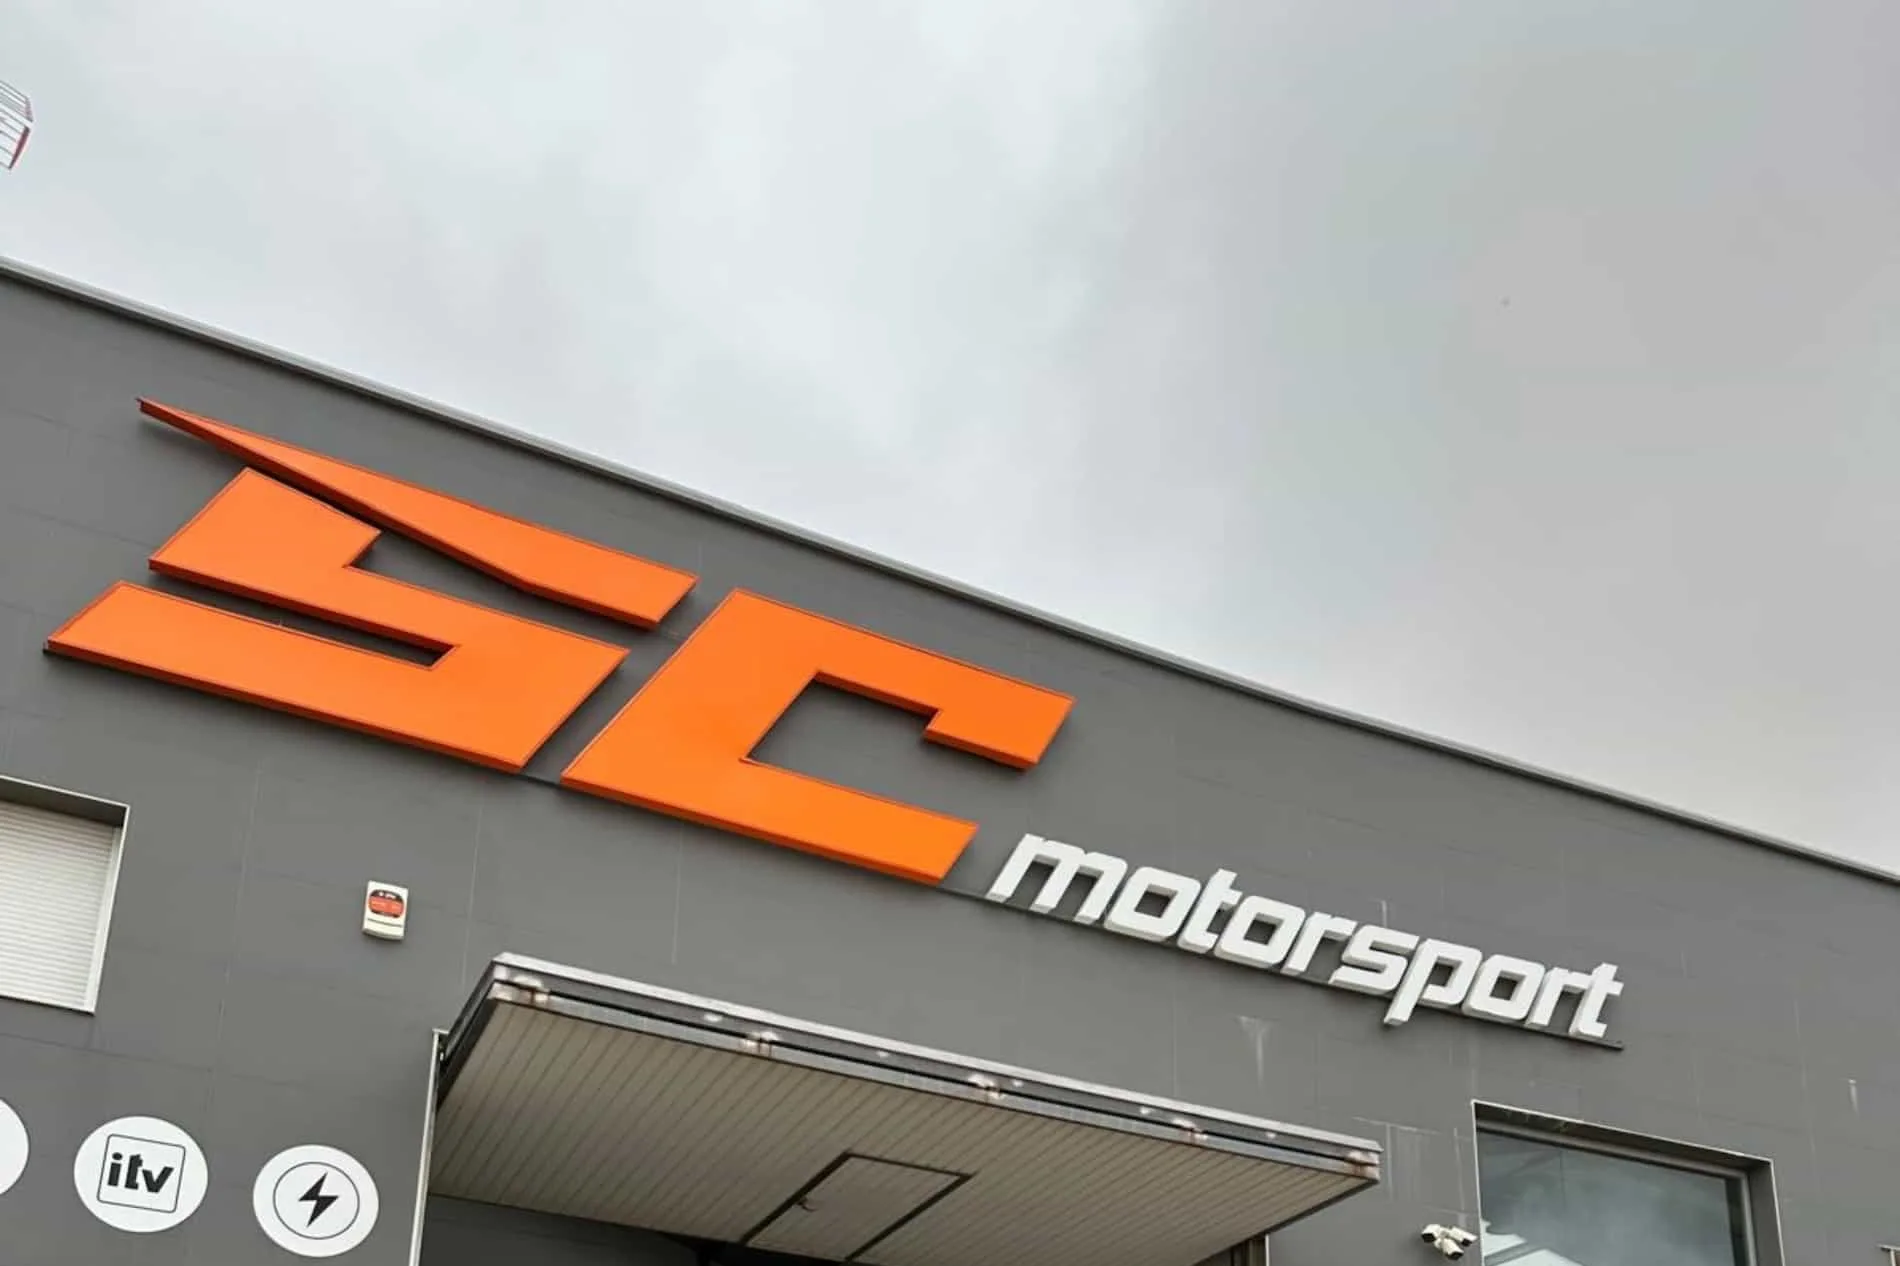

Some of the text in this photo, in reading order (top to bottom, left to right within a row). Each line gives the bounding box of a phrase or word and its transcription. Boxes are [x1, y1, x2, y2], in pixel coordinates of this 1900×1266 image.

[44, 398, 1624, 1038] SC motorsport
[107, 1152, 174, 1193] itv
